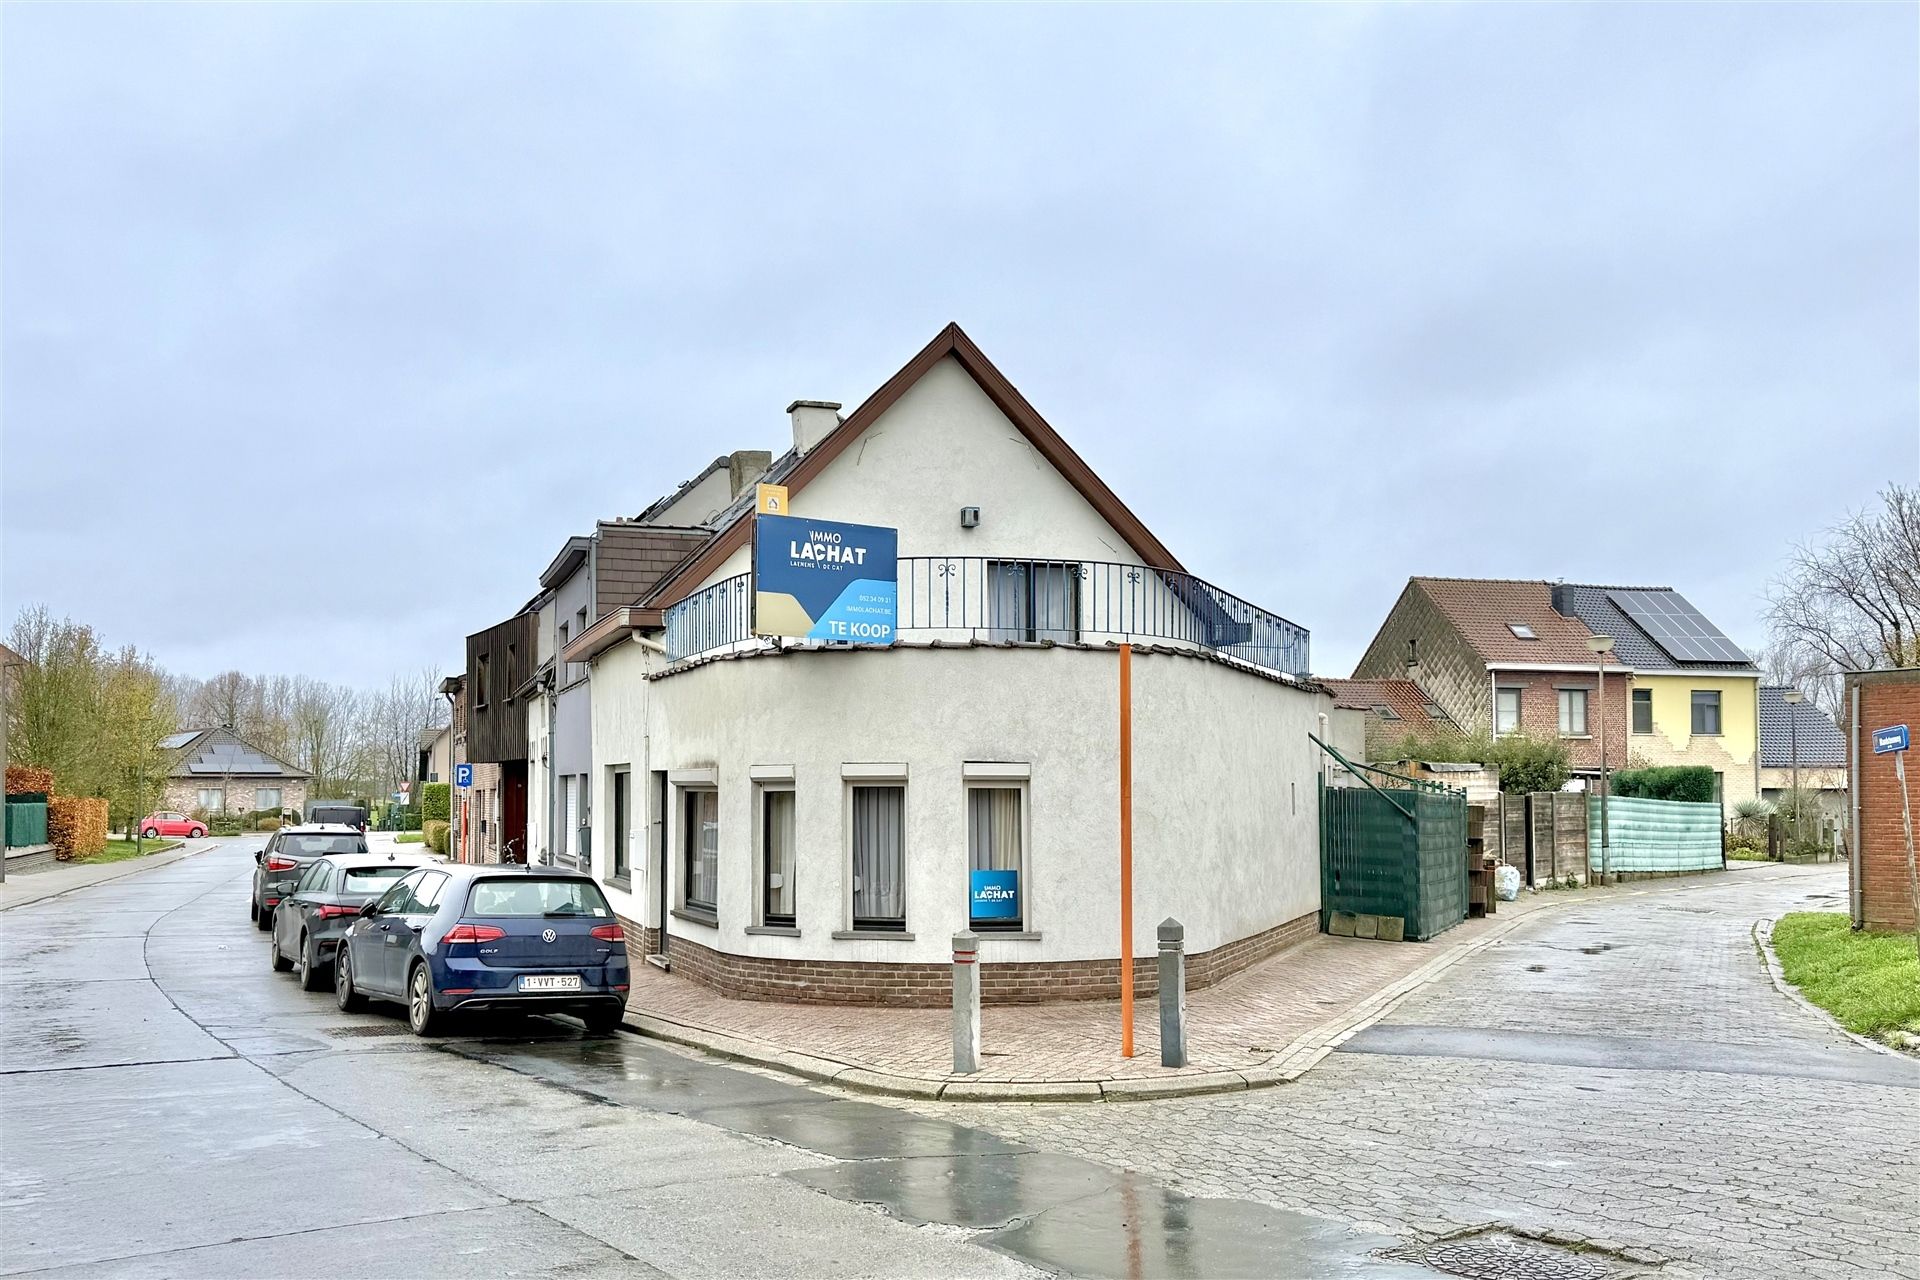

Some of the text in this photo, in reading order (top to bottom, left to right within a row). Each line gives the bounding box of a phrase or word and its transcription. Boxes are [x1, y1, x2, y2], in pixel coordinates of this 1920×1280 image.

[810, 530, 842, 544] IMMO
[790, 540, 867, 565] LACHAT
[828, 620, 891, 638] TE KOOP
[458, 767, 470, 783] P
[974, 890, 1015, 899] LACHAT
